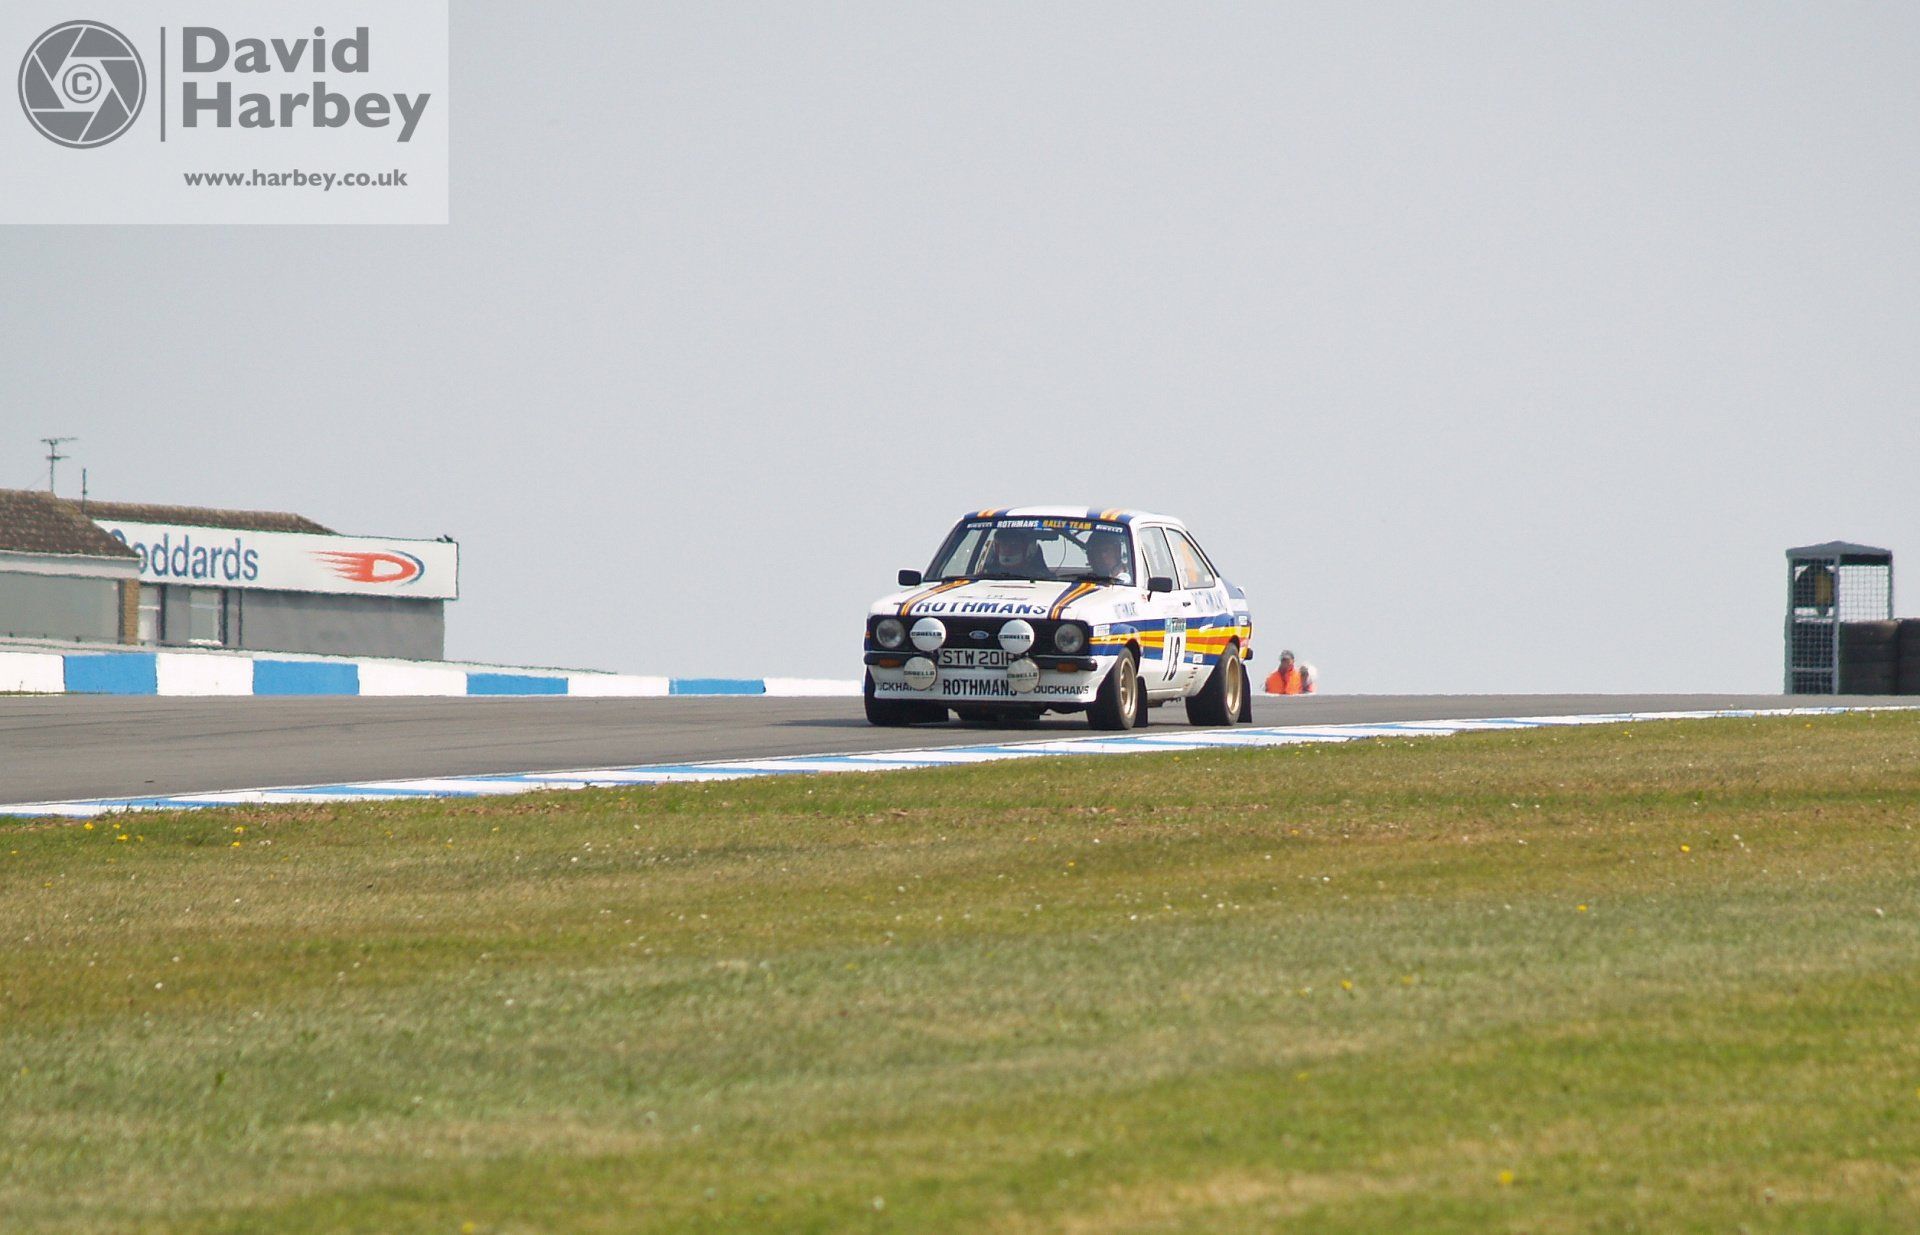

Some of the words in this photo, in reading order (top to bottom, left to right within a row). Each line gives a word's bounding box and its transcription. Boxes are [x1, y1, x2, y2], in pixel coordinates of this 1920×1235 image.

[996, 520, 1039, 529] ROTHMANS
[1042, 520, 1067, 529] RALLY
[1069, 521, 1092, 530] TEAM
[915, 601, 1049, 616] ROTHMANS
[942, 650, 975, 665] STW
[1162, 636, 1181, 682] 18
